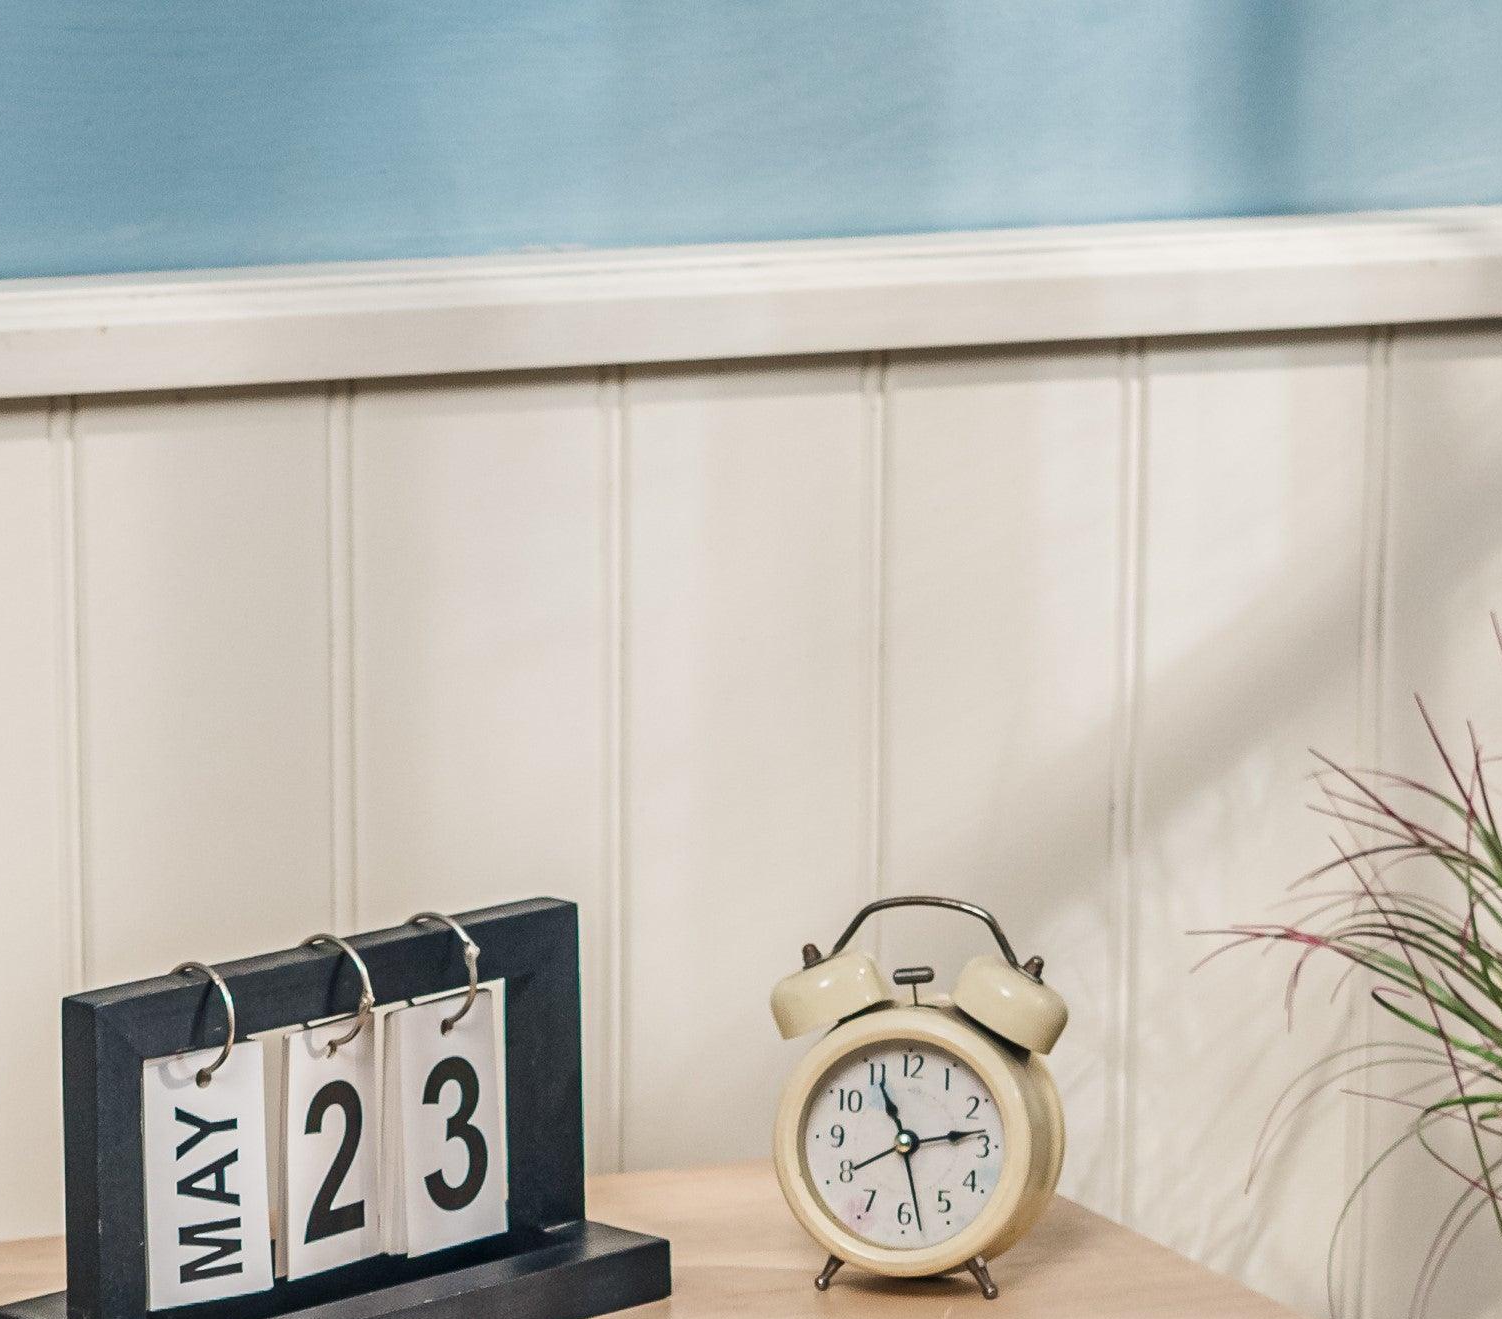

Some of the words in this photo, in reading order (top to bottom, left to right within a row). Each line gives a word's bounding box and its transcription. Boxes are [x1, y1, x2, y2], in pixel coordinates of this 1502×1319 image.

[870, 1063, 886, 1086] 11
[903, 1054, 924, 1079] 12
[944, 1067, 951, 1092] 1
[839, 1088, 863, 1113] 10
[965, 1096, 980, 1120] 2
[830, 1124, 845, 1148] 9
[976, 1135, 990, 1158] 3
[174, 1105, 244, 1286] MAY
[303, 1079, 366, 1245] 2
[420, 1056, 490, 1212] 3
[839, 1160, 854, 1183] 8
[962, 1169, 977, 1193] 4
[863, 1189, 877, 1213] 7
[938, 1190, 951, 1214] 5
[897, 1202, 912, 1226] 6
